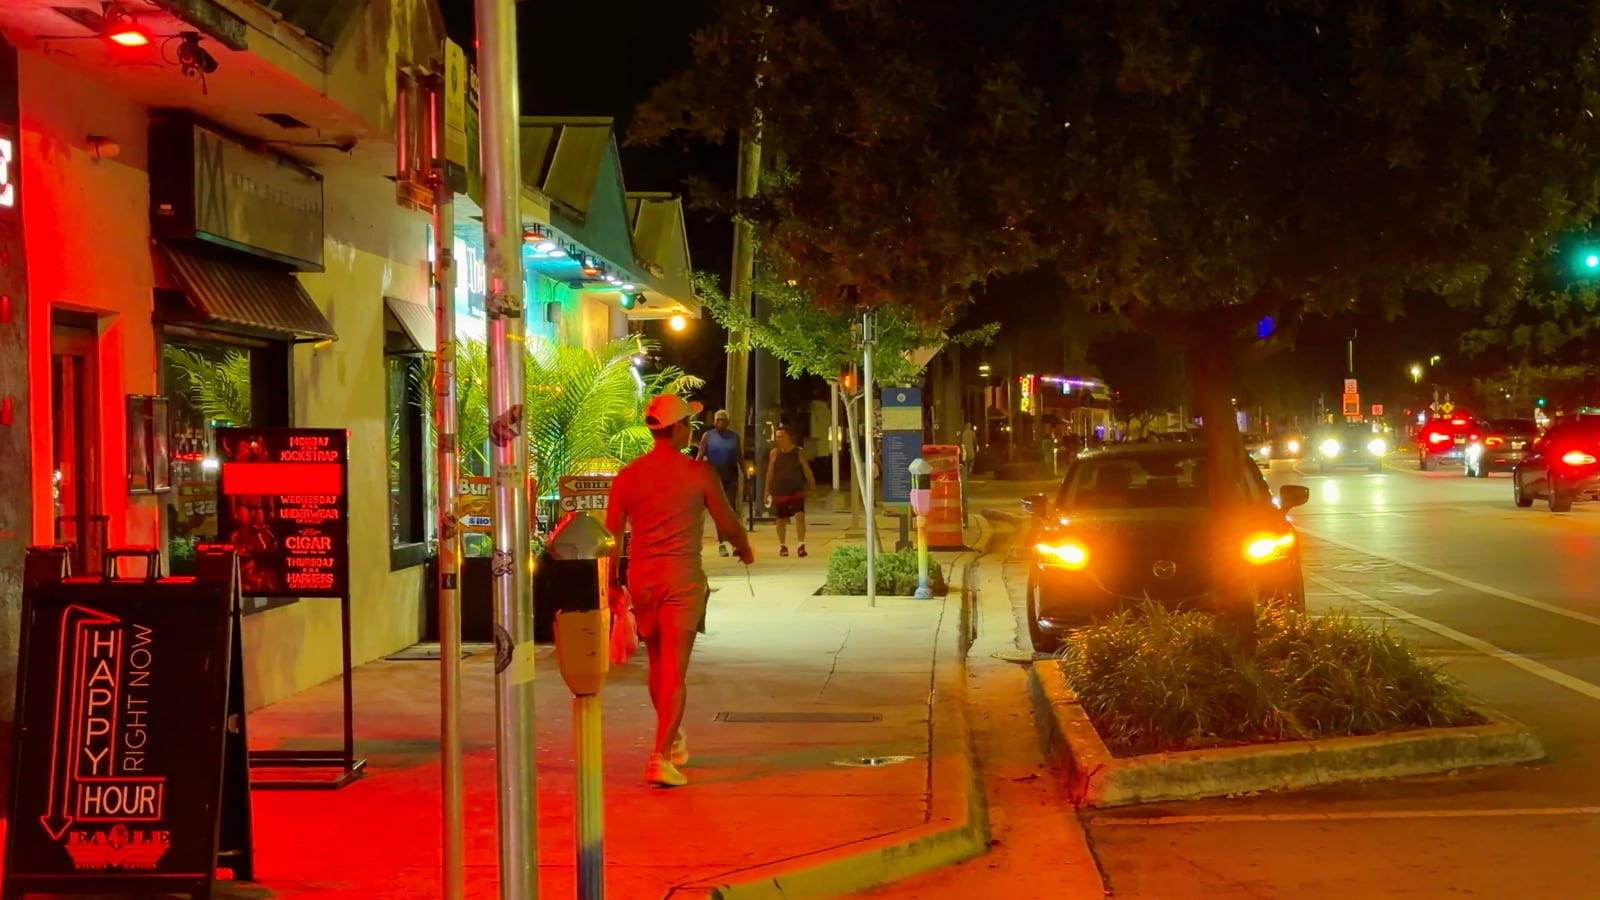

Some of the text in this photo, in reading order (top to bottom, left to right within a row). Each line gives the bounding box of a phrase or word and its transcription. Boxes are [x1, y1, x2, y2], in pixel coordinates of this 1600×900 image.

[289, 436, 330, 447] MONDAY
[280, 450, 339, 462] JOCKSTRAP
[280, 495, 337, 504] WEDNESDAY
[280, 508, 339, 519] UNDERWEAR
[285, 536, 332, 550] CIGAR
[286, 557, 335, 567] THURSDAY
[286, 573, 334, 583] HARNESS
[84, 629, 117, 775] HAPPY
[123, 624, 153, 771] RIGHT NOW
[84, 785, 156, 814] HOUR
